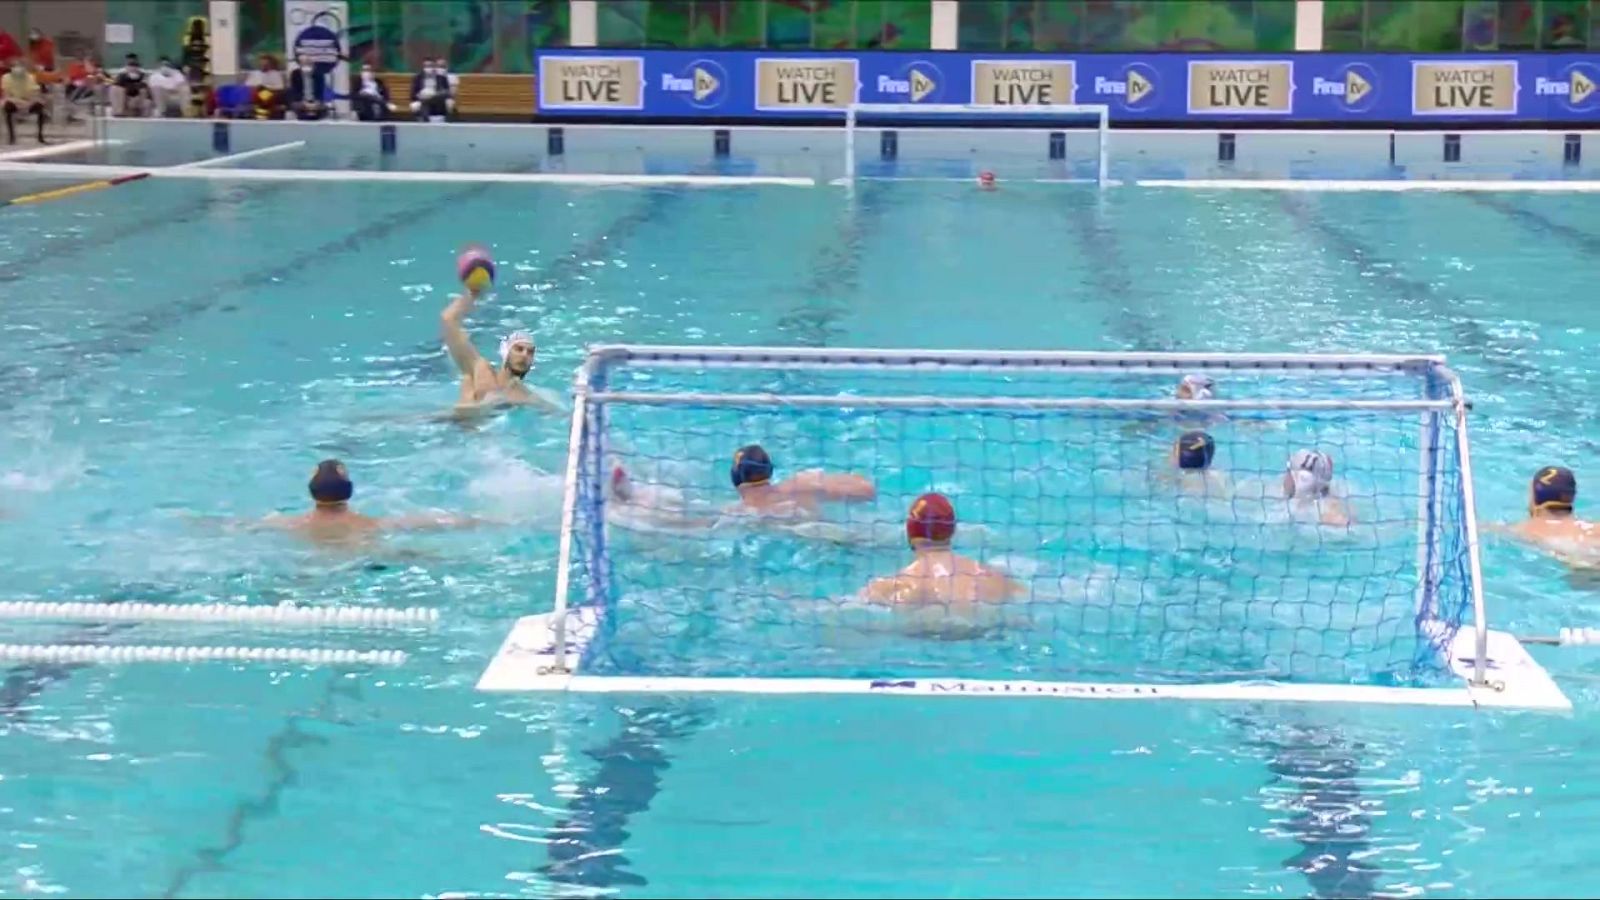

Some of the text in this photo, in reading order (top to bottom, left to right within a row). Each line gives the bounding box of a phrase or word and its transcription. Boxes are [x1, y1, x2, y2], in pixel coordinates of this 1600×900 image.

[562, 65, 621, 79] WATCH
[777, 67, 836, 81] WATCH
[993, 68, 1053, 82] WATCH
[1210, 69, 1269, 83] WATCH
[1434, 69, 1494, 83] WATCH
[562, 80, 620, 102] LIVE
[778, 82, 835, 104] LIVE
[993, 84, 1053, 106] LIVE
[1210, 85, 1269, 107] LIVE
[1435, 85, 1494, 108] LIVE
[1540, 468, 1558, 486] 2
